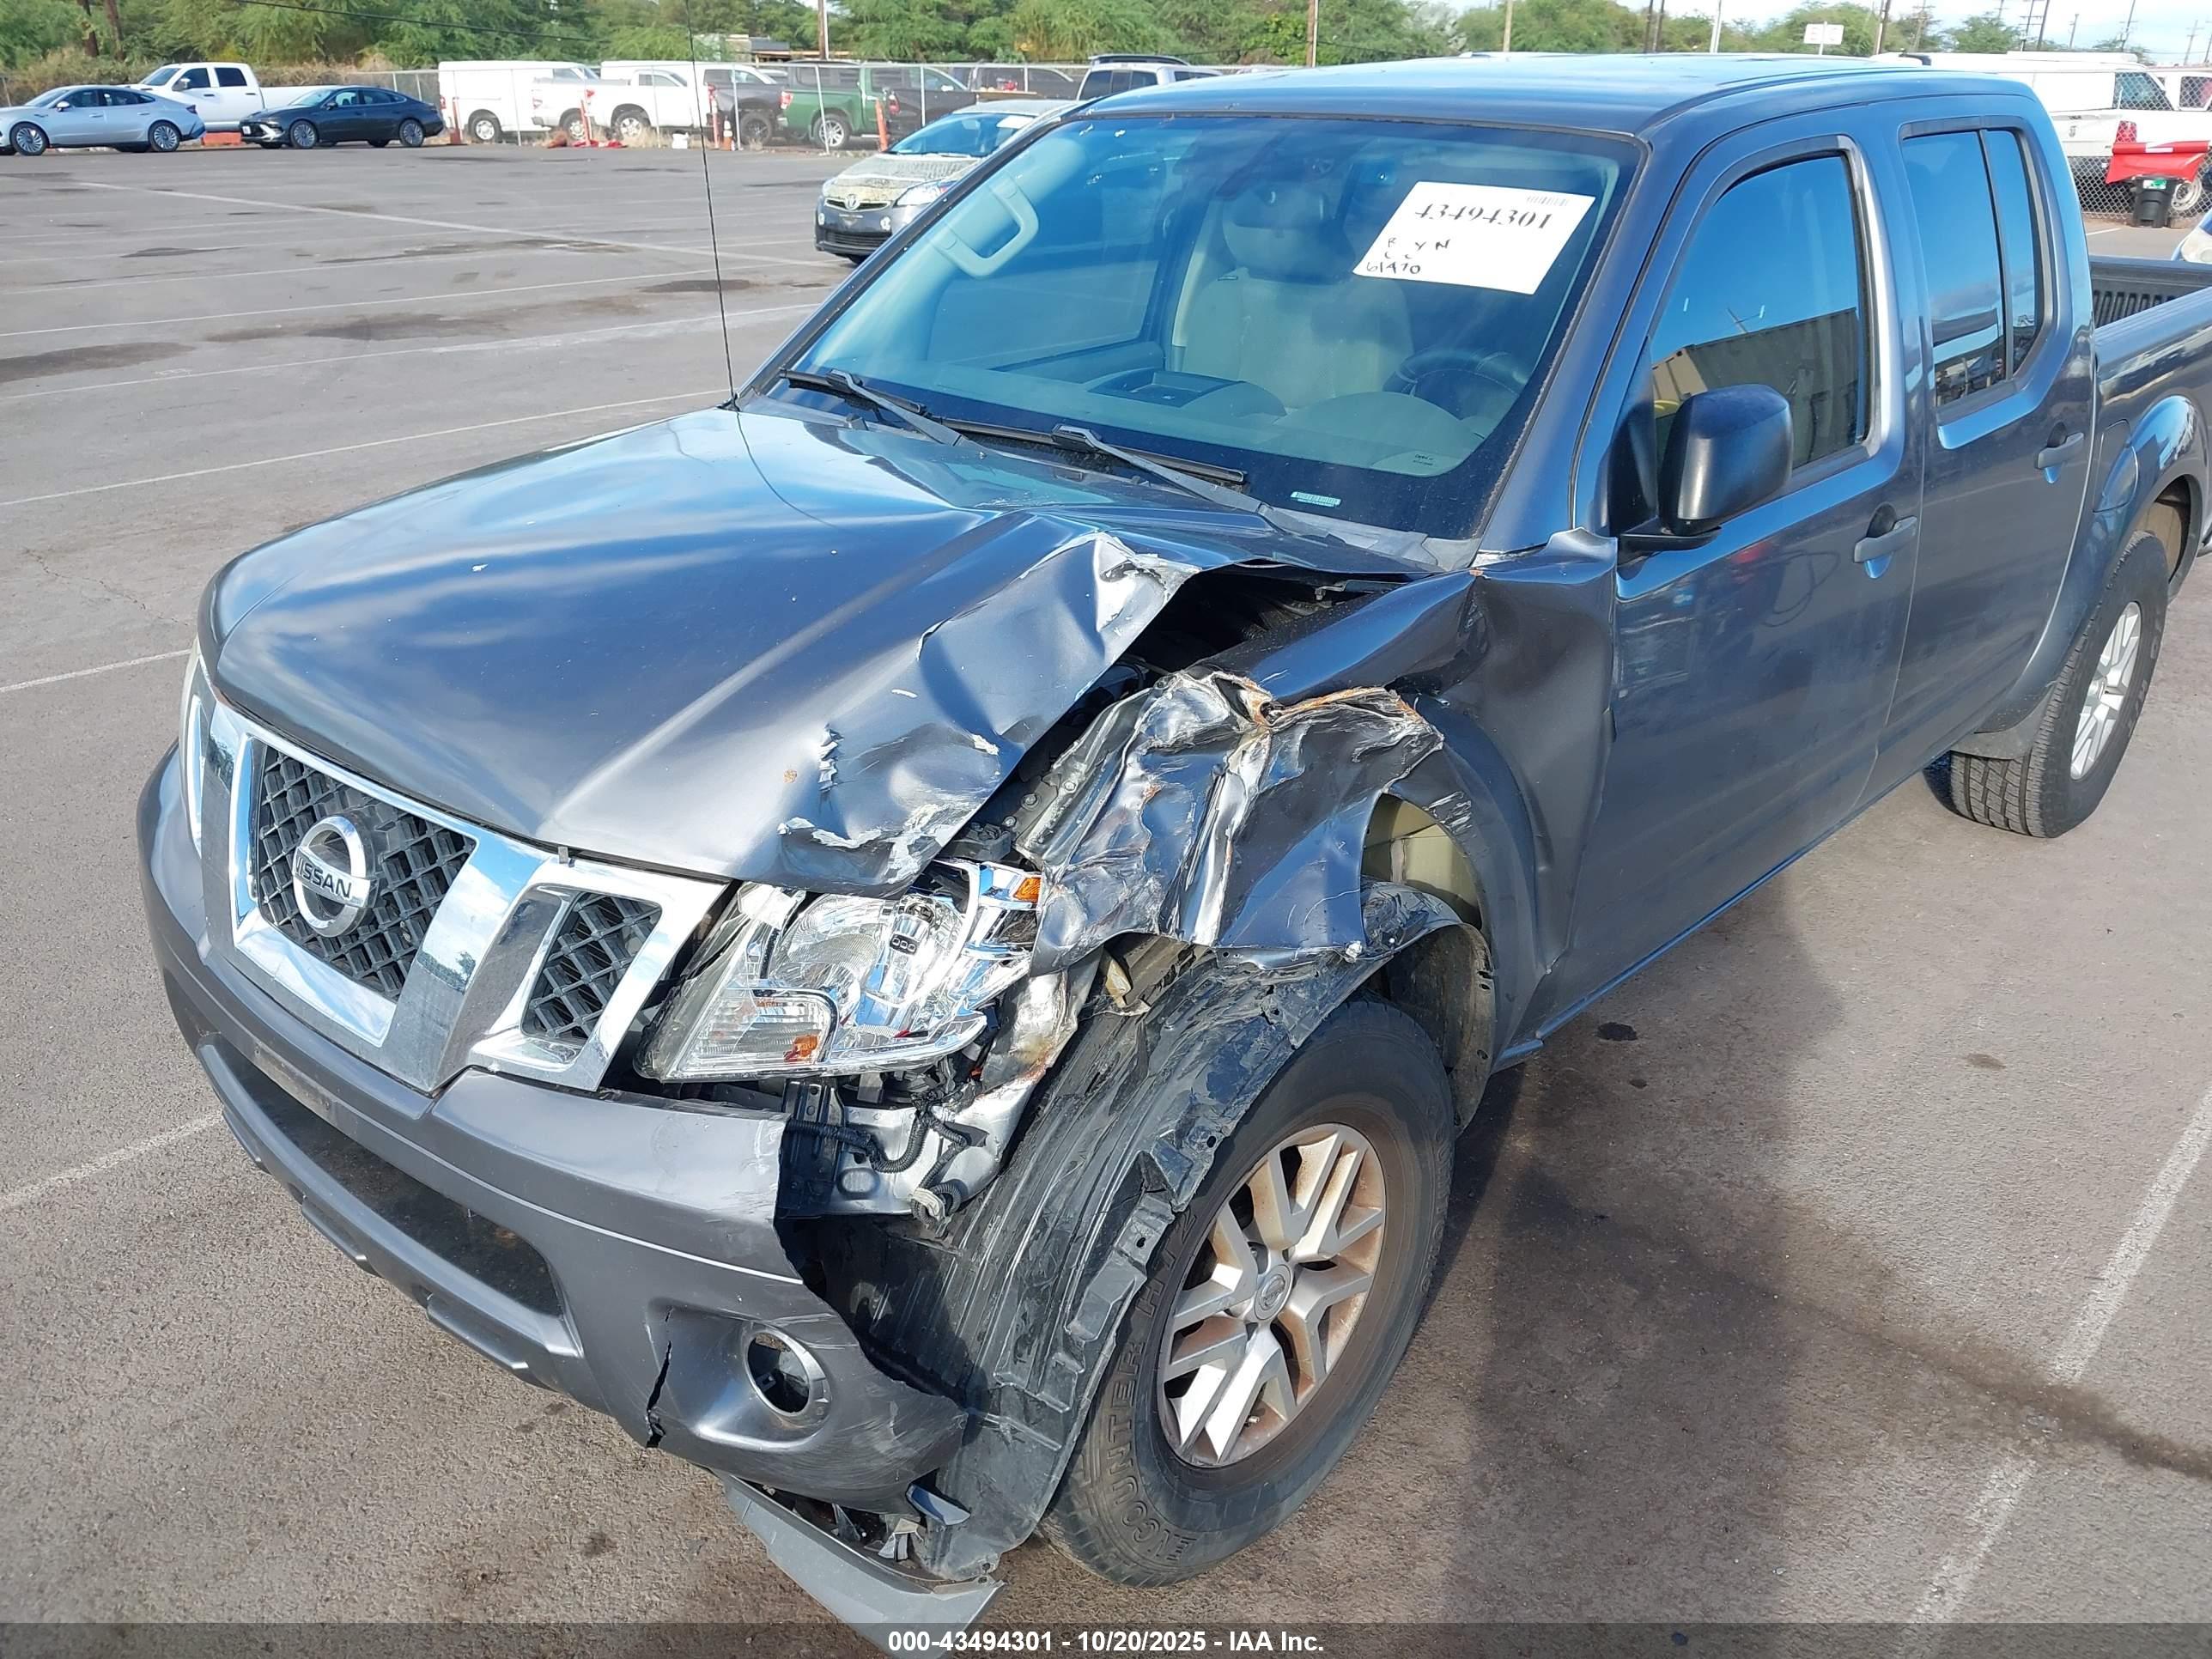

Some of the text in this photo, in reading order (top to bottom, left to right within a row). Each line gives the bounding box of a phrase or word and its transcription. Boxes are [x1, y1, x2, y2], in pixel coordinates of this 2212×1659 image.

[1414, 203, 1553, 229] 43494301
[295, 855, 352, 898] NISSAN
[1106, 1340, 1197, 1564] ENCOUNTER
